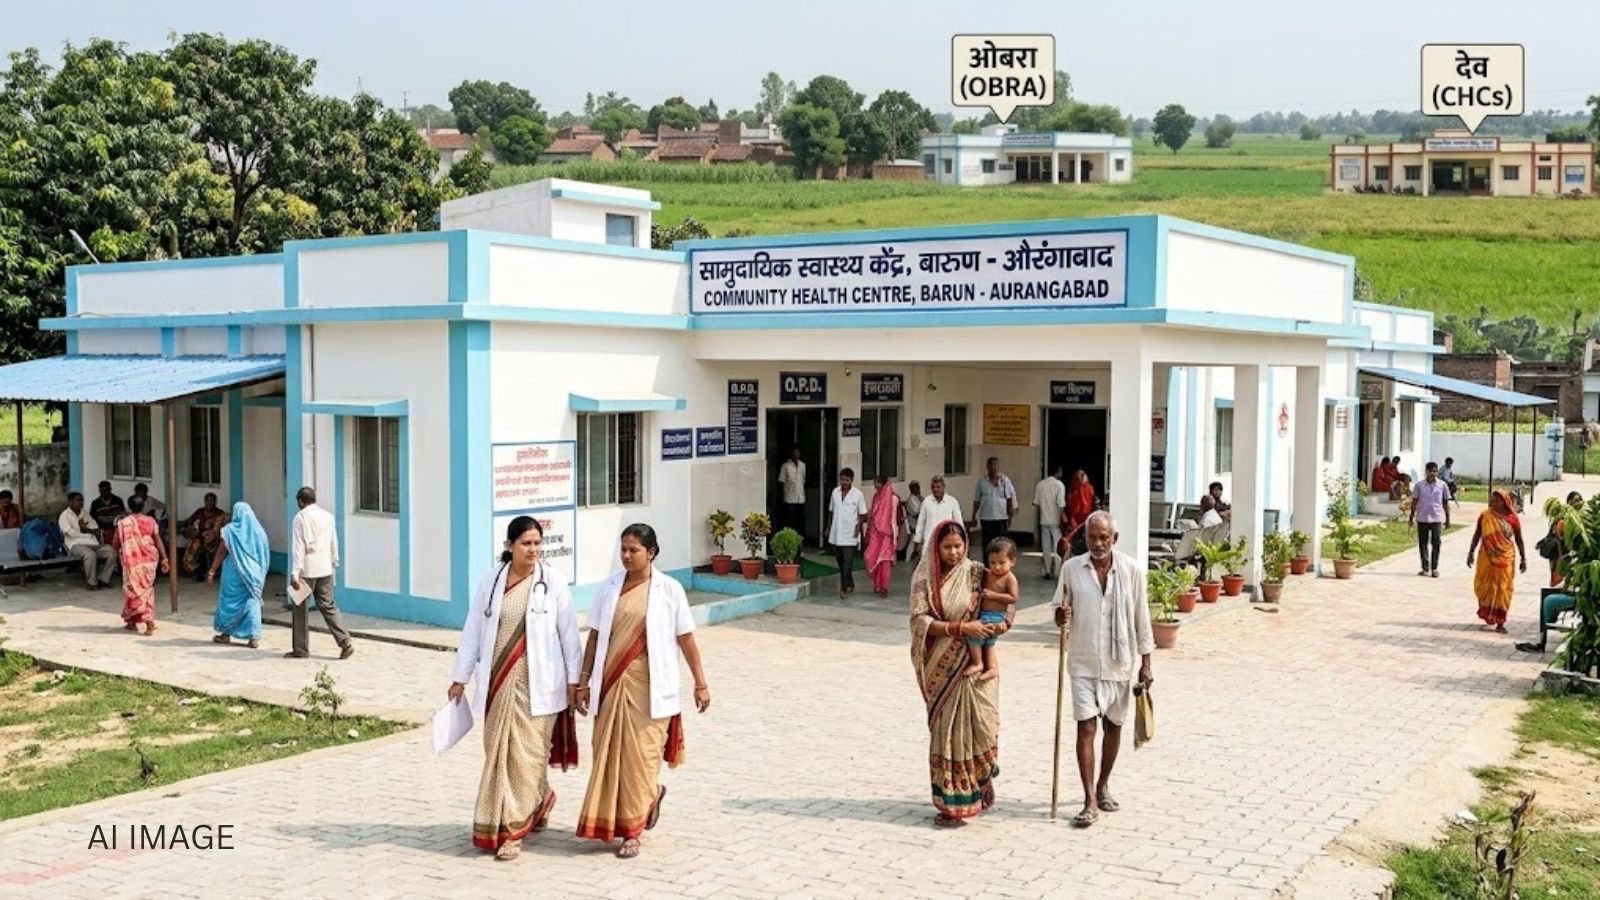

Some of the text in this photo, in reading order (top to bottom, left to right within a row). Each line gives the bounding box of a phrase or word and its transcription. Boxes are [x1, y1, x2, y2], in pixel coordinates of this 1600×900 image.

[699, 252, 792, 288] सामुदायिक
[797, 256, 864, 278] स्वास्थ्य
[870, 246, 912, 276] केंद्र,
[919, 251, 981, 273] बारुण
[1002, 239, 1115, 271] औरंगाबाद
[704, 289, 787, 306] COMMUNITY
[792, 287, 848, 305] HEALTH
[852, 285, 916, 305] CENTRE,
[921, 284, 975, 301] BARUN
[989, 280, 1109, 300] AURANGABAD
[785, 377, 822, 393] O.P.D.
